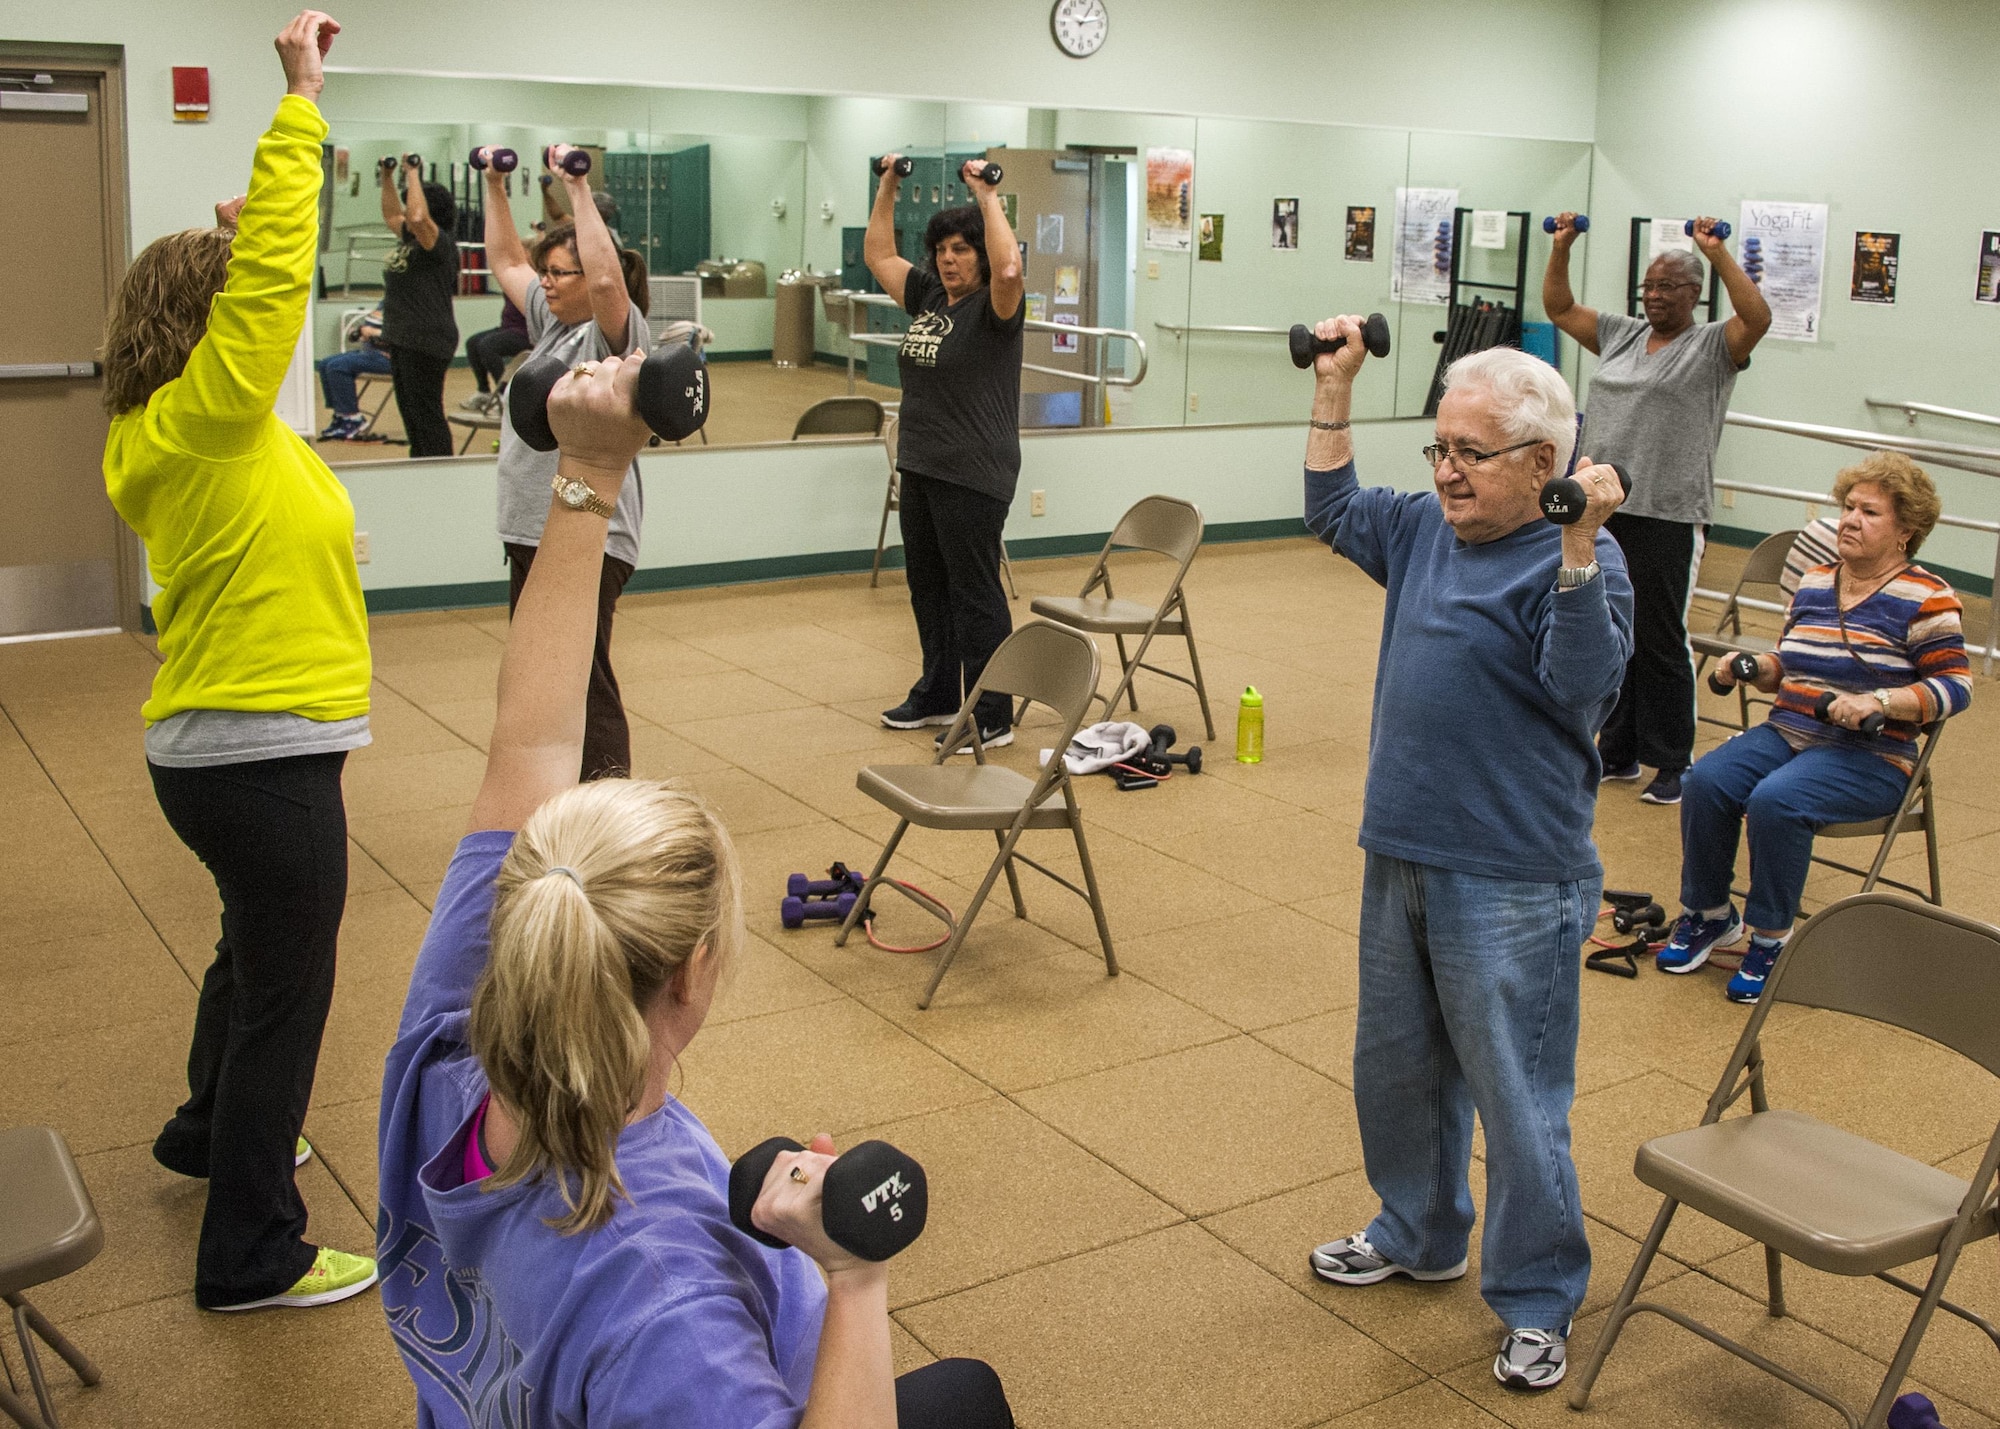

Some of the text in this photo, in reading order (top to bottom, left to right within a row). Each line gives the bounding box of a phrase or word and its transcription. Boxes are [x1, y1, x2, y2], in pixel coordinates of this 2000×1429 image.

[1751, 207, 1814, 238] YogaFit
[901, 343, 939, 359] FEAR
[685, 386, 695, 398] 5
[1553, 494, 1560, 503] 3
[1547, 505, 1569, 513] VTX
[861, 1171, 901, 1214] VTX
[889, 1202, 904, 1222] 5
